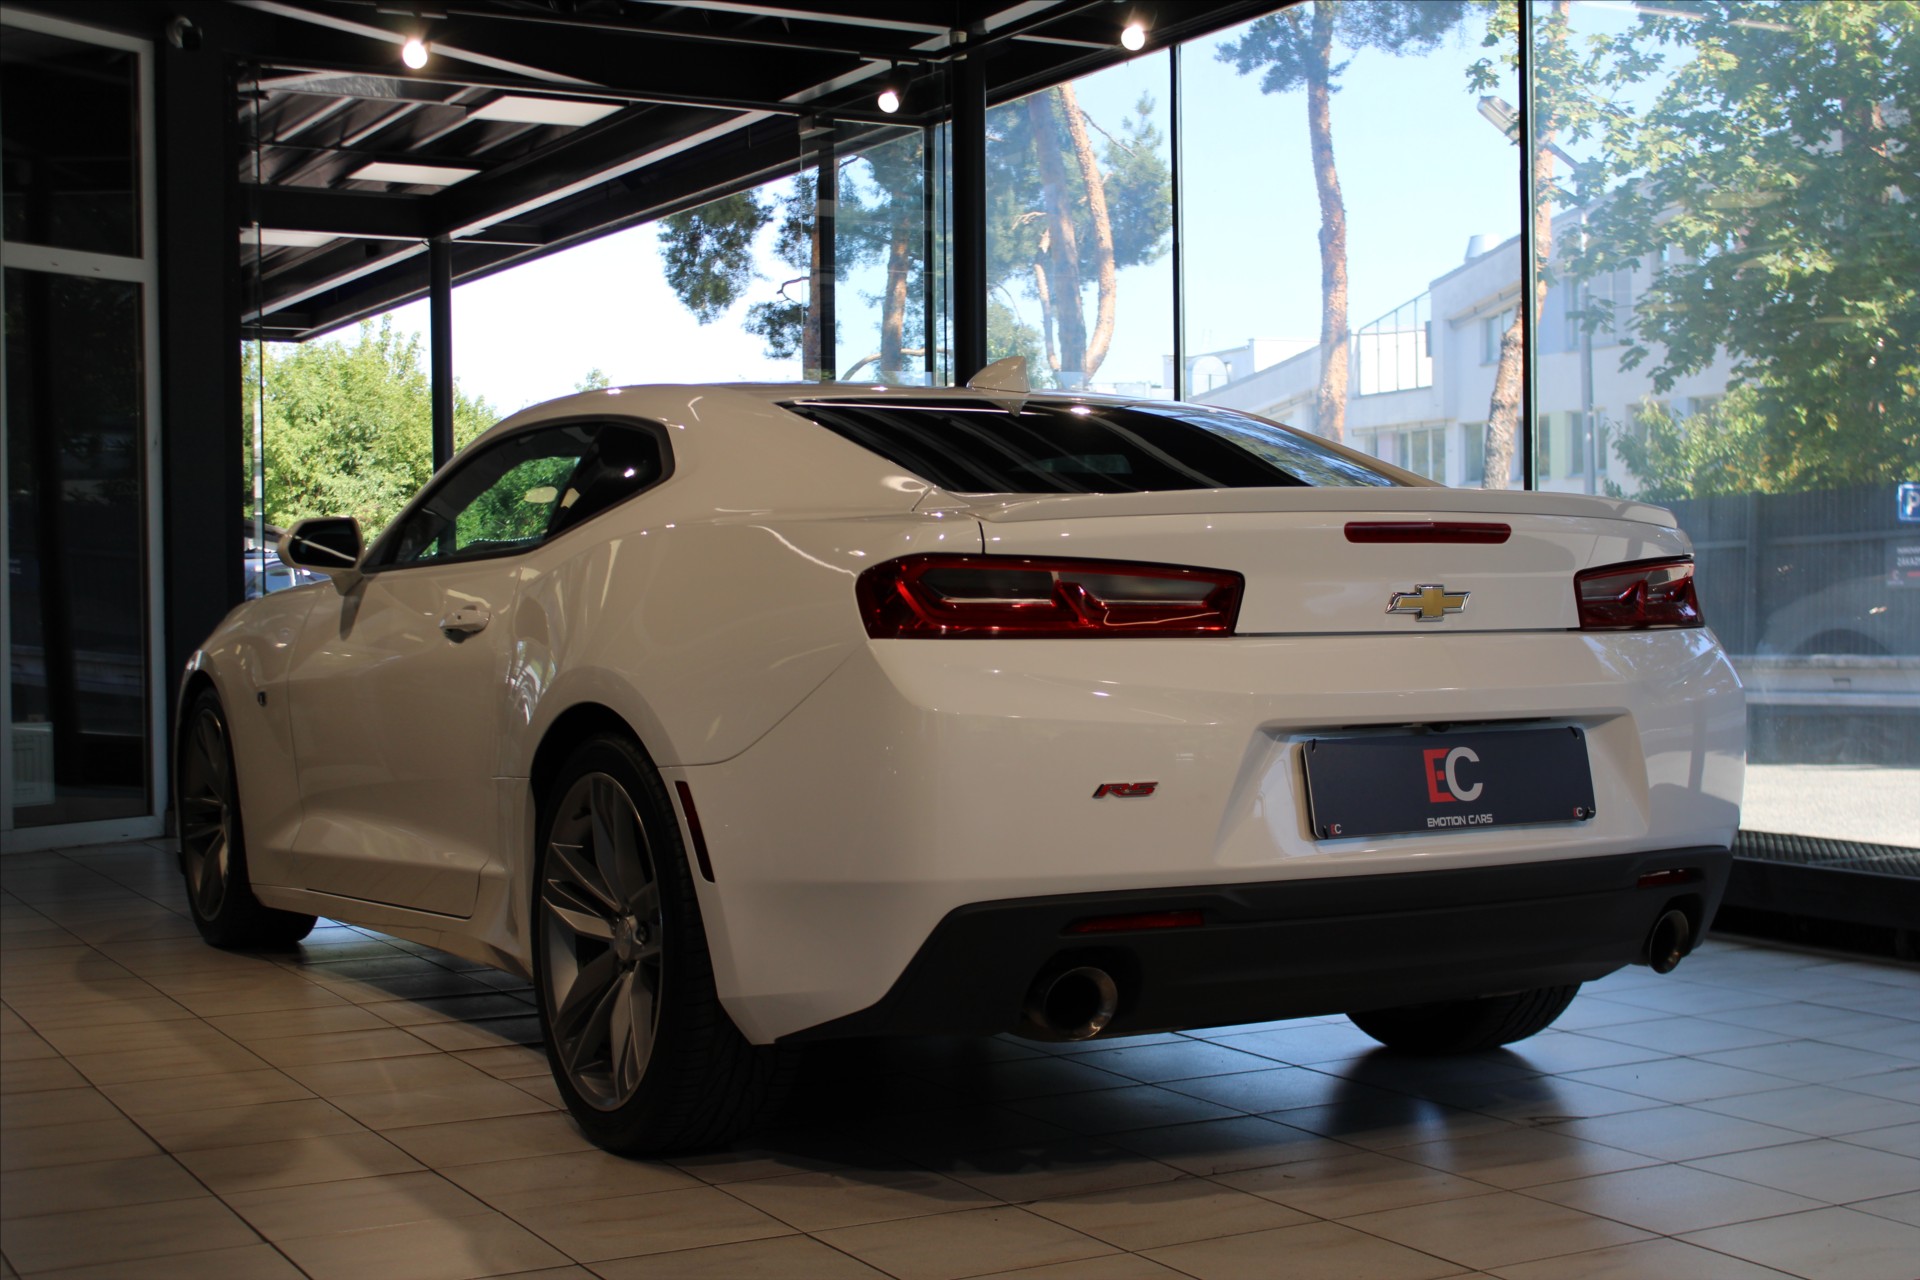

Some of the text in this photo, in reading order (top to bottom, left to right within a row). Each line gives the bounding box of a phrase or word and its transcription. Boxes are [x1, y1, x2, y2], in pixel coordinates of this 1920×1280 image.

[1906, 490, 1920, 515] P
[1423, 746, 1483, 803] EC
[1092, 782, 1159, 799] RS
[1427, 813, 1493, 828] EMOTION CARS
